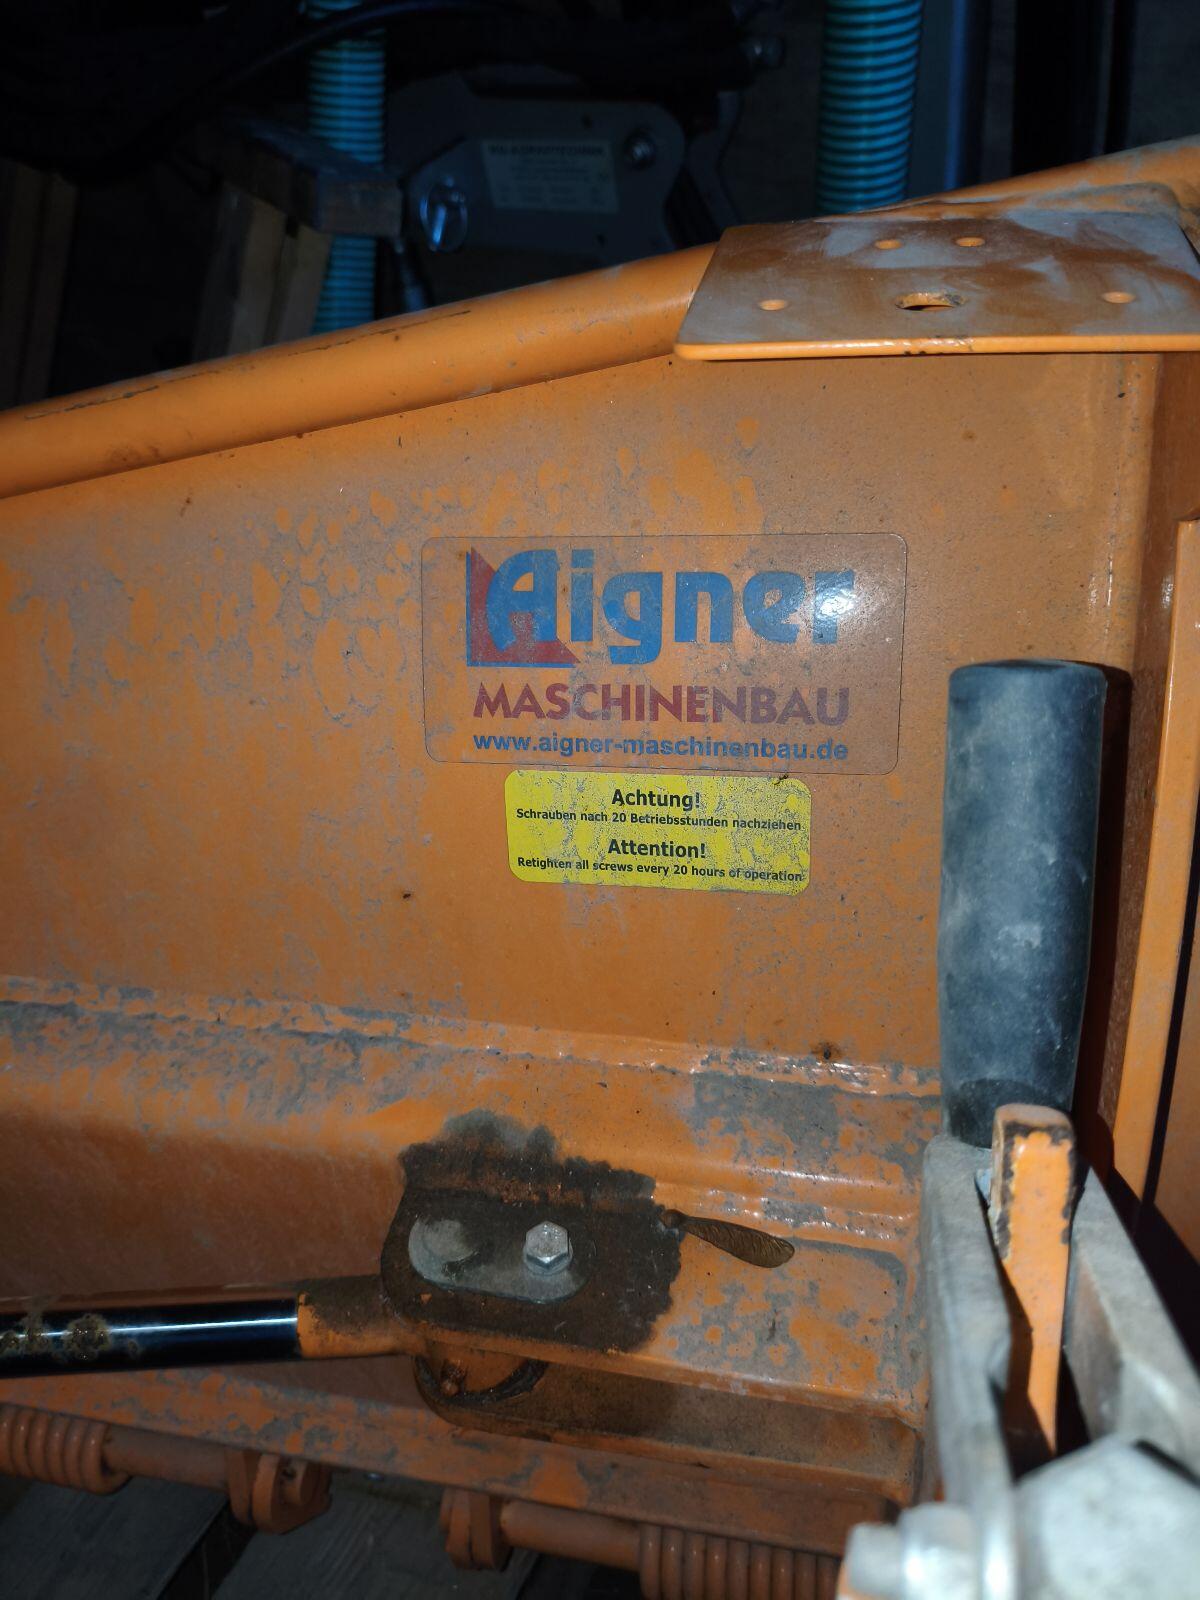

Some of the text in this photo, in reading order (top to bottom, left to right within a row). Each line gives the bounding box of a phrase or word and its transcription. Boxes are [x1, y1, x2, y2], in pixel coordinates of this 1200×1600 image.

[486, 549, 854, 665] Aigner
[473, 681, 850, 726] MASCHINENBAU
[474, 732, 849, 761] www.aigner-maschinenbau.de
[612, 789, 701, 811] Achtung!
[516, 808, 802, 830] Schrauben nach 20 Betriebsstunden nachziehen
[608, 838, 706, 858] Attention!
[517, 857, 803, 882] Retighten all screws every 20 hours of operation
